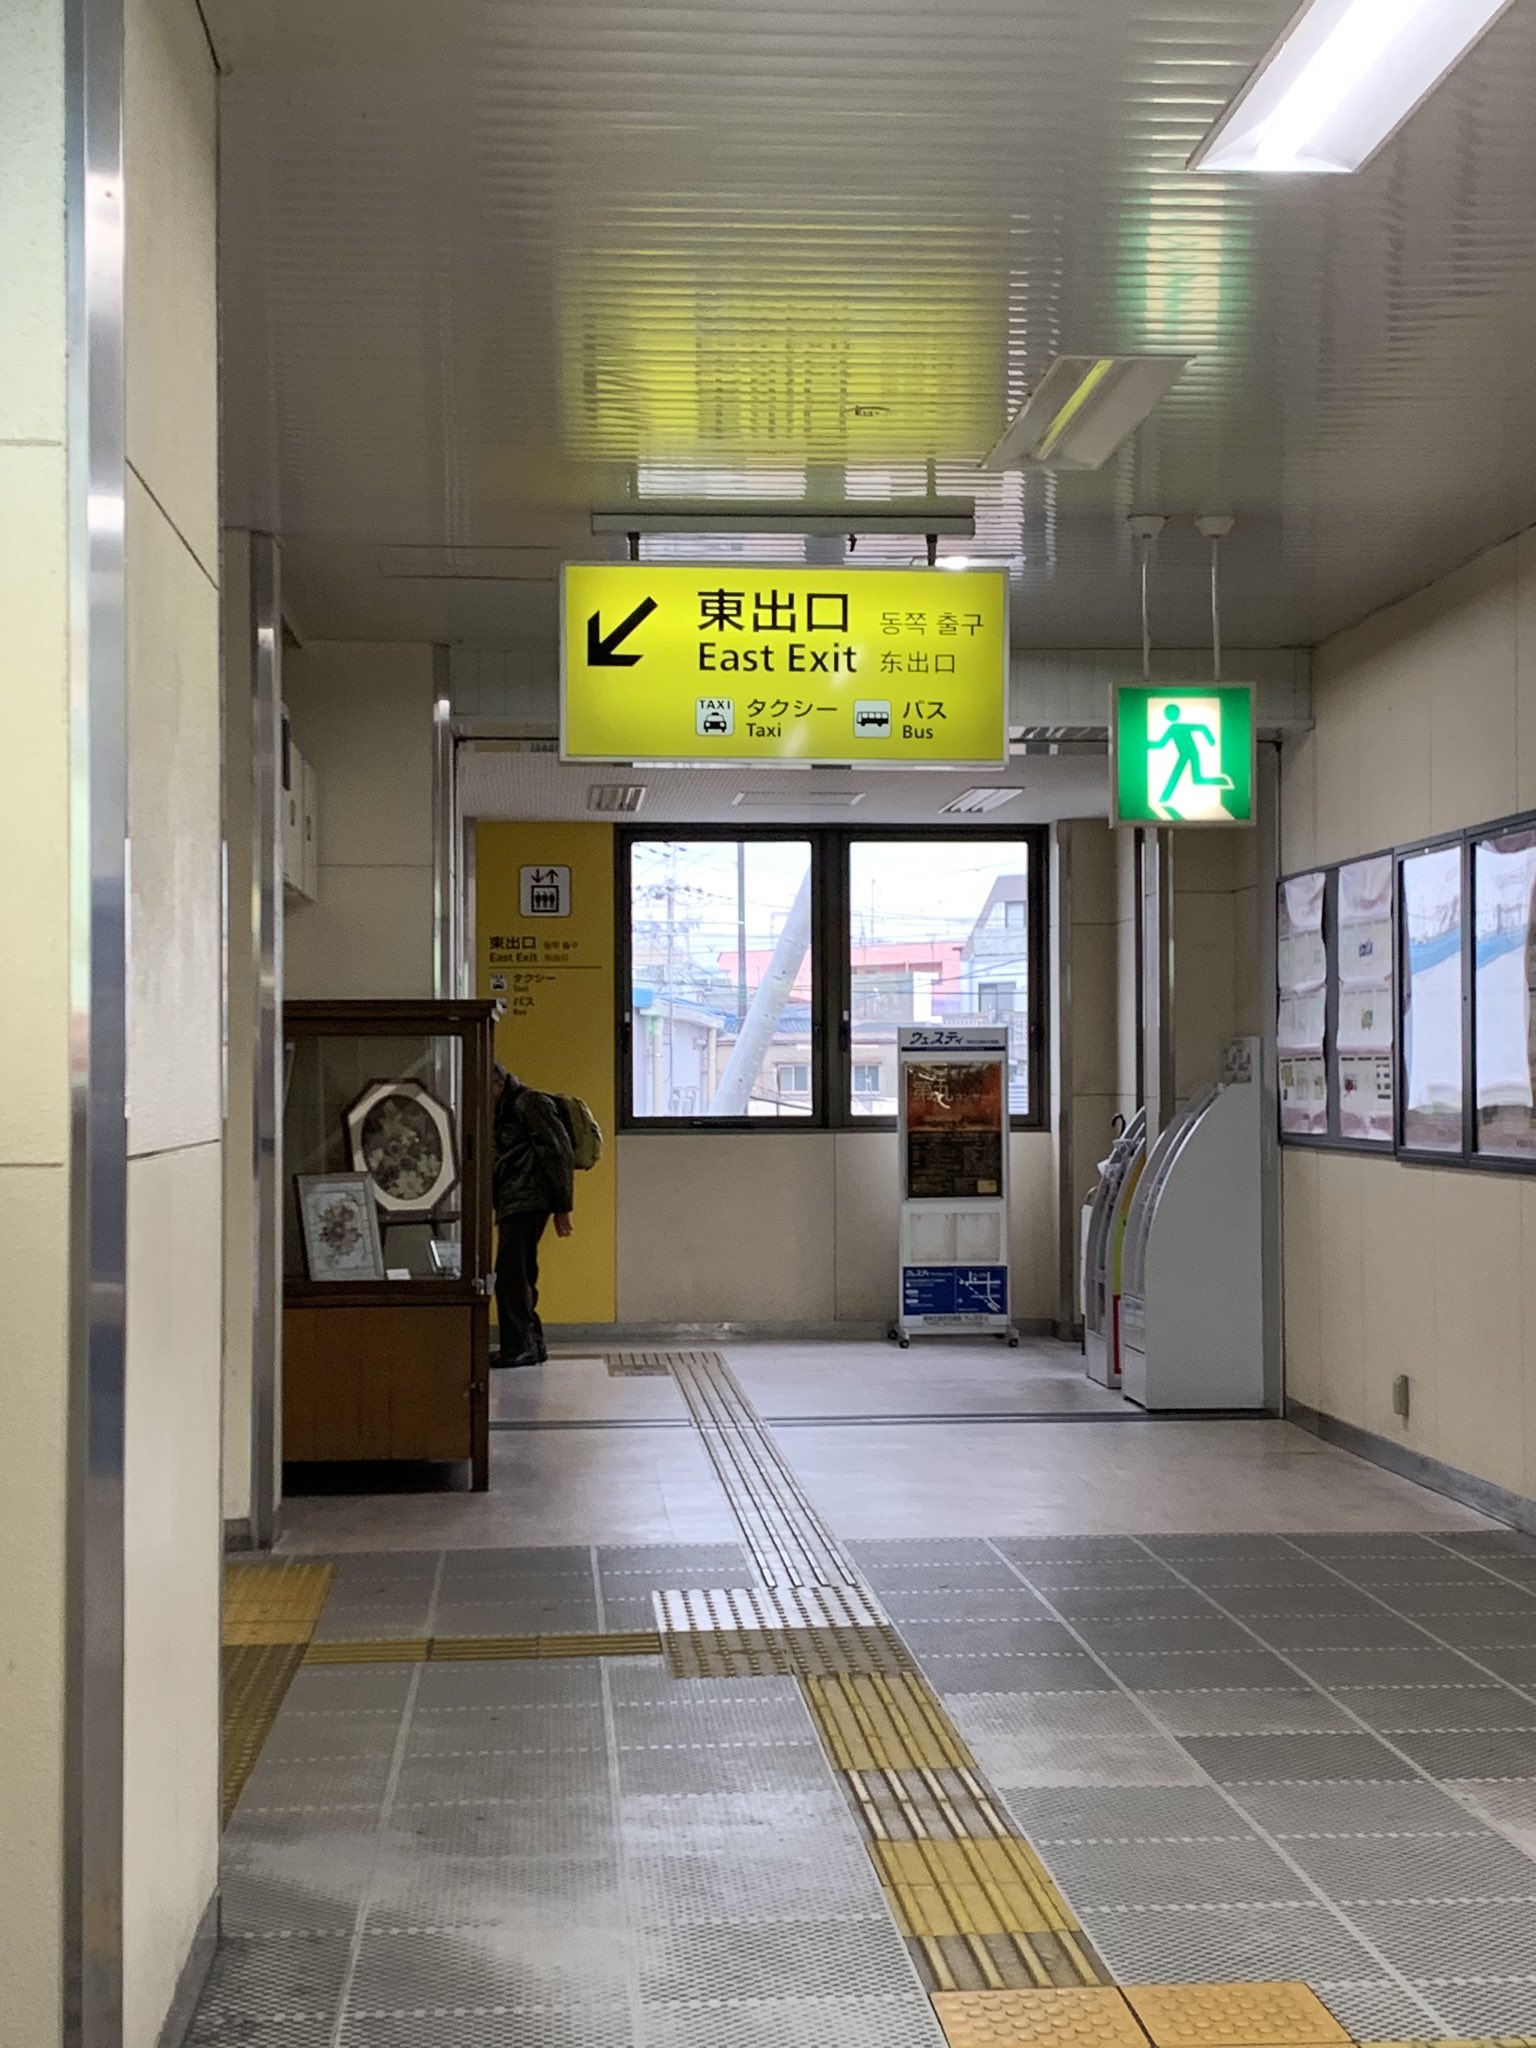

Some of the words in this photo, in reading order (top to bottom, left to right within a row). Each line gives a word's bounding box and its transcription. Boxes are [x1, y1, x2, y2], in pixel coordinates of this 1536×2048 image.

[698, 589, 848, 632] 東出口
[880, 612, 927, 636] 동쪽
[937, 612, 984, 636] 출구
[700, 642, 774, 672] East
[788, 642, 857, 673] Exit
[880, 651, 955, 674] 东出口
[700, 700, 731, 709] TAXI
[747, 698, 838, 718] タクシー
[902, 701, 947, 720] バス
[747, 723, 781, 737] Taxi
[902, 725, 934, 739] Bus
[490, 936, 536, 949] 東出口
[490, 952, 513, 962] East
[516, 952, 537, 962] Exit
[513, 973, 556, 983] タクシー
[513, 996, 535, 1006] バス
[909, 1031, 964, 1045] ウェスティ
